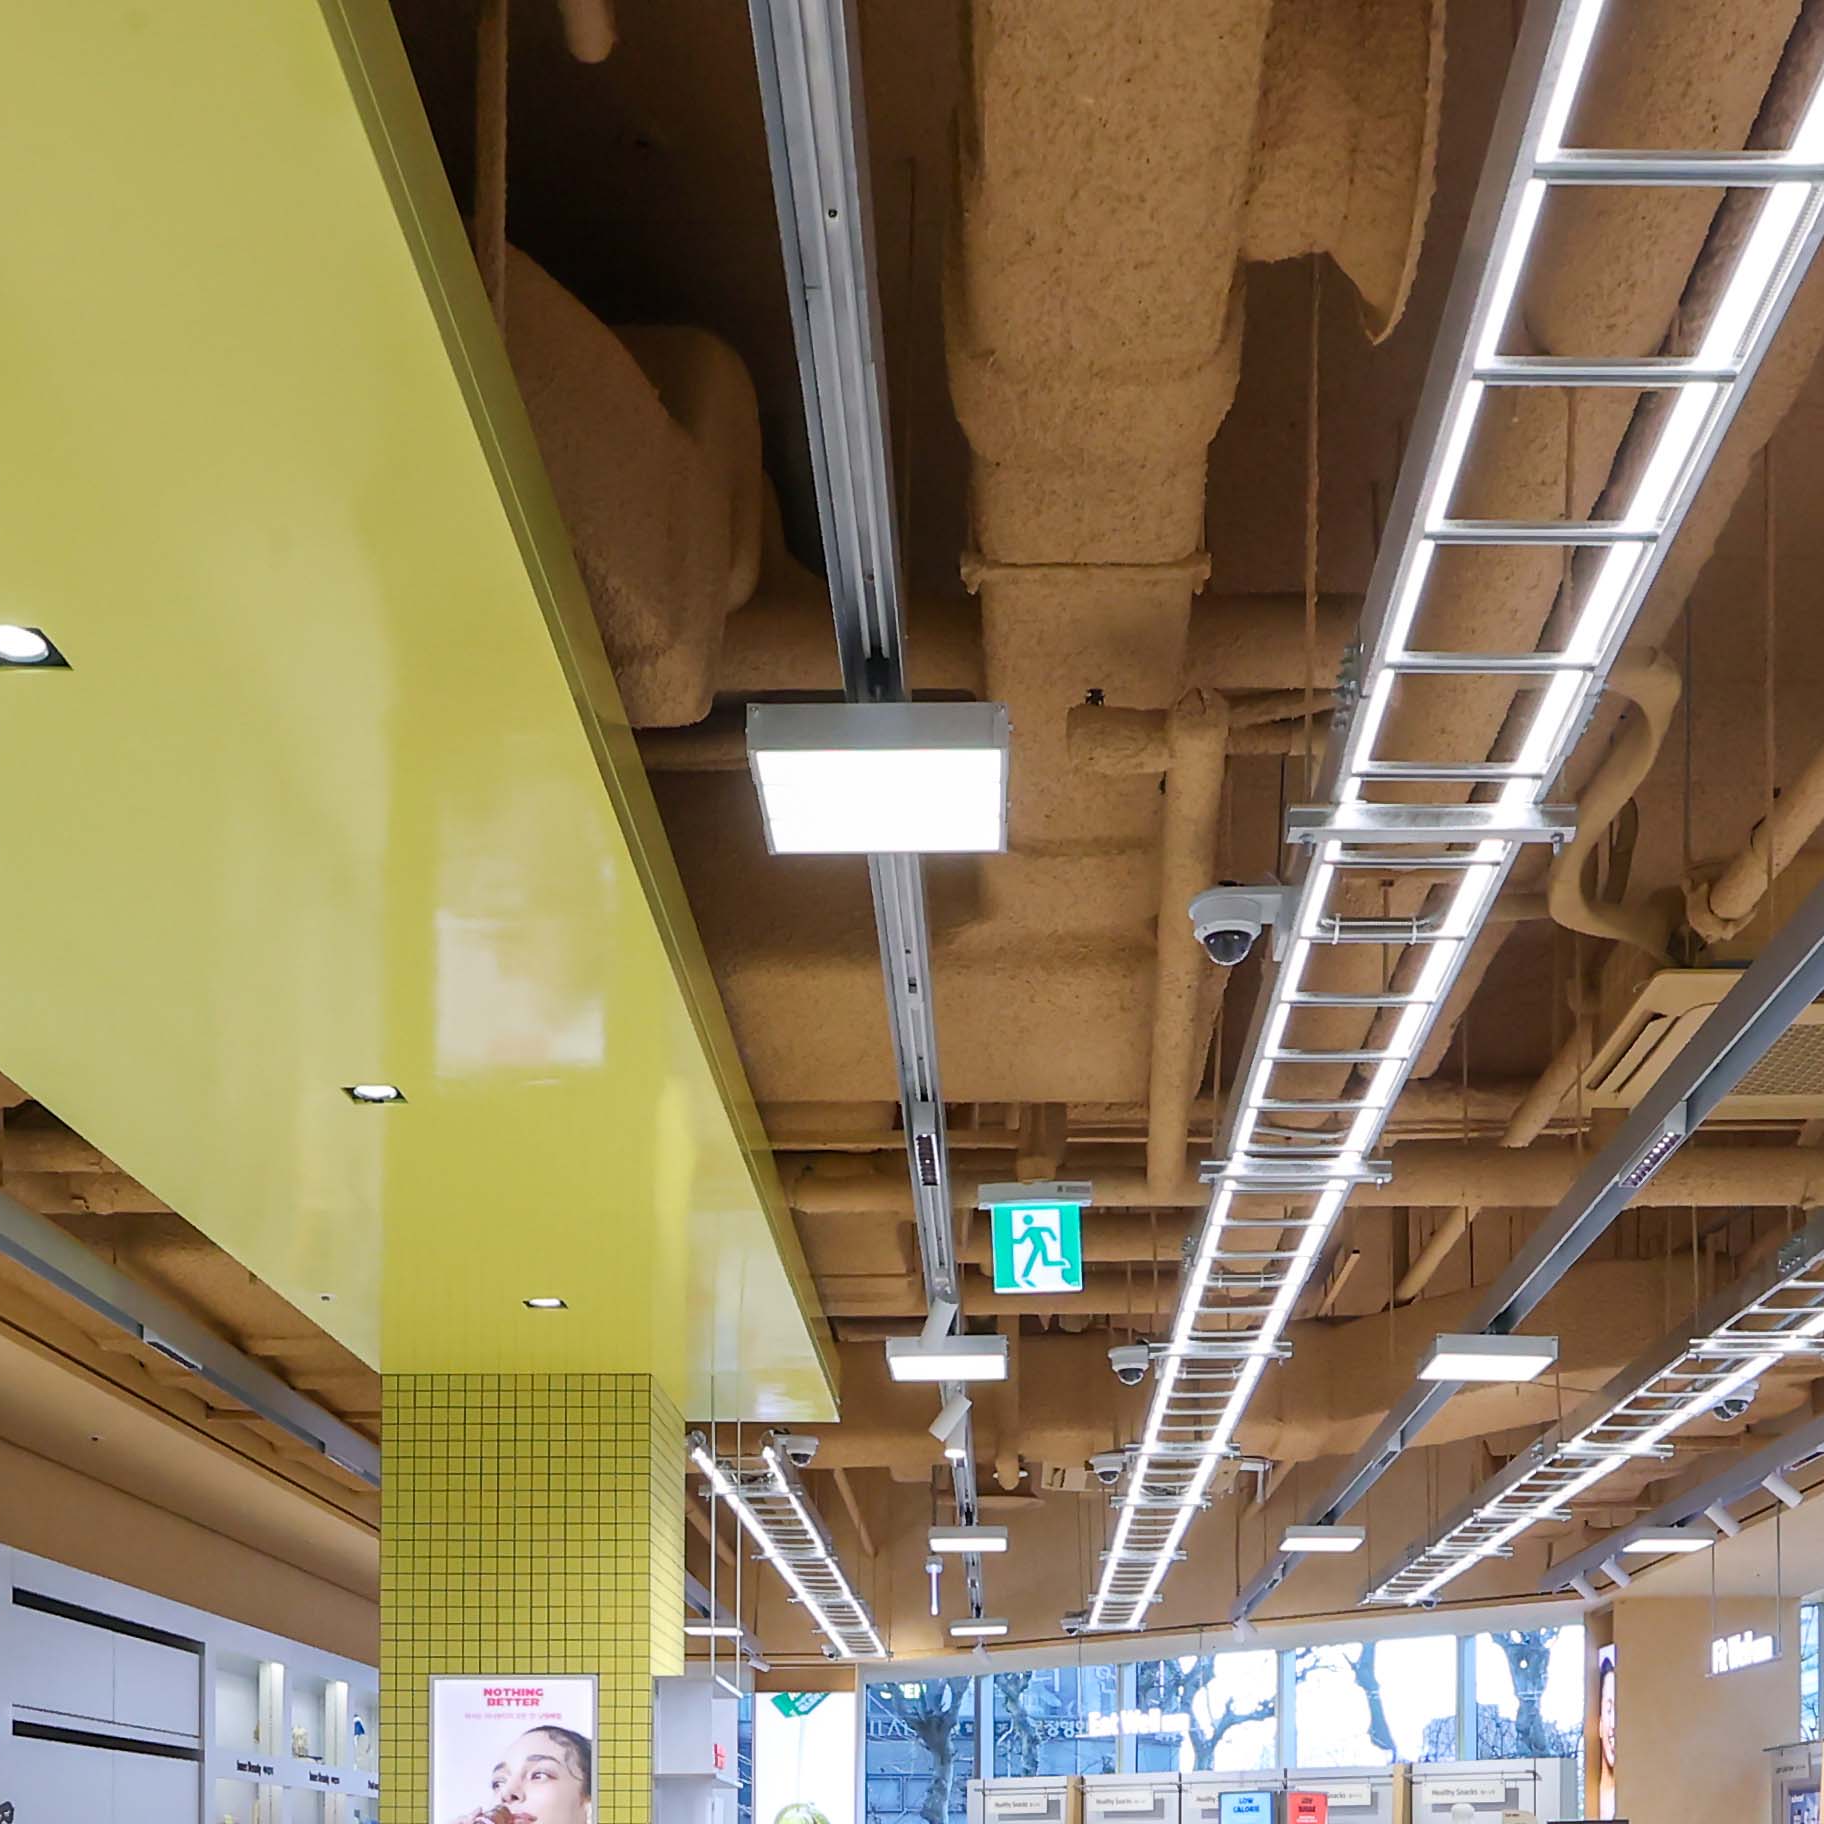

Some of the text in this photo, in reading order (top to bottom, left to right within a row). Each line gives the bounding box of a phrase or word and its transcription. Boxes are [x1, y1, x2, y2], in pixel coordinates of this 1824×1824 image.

[483, 1688, 544, 1697] NOTHING
[487, 1698, 540, 1707] BETTER
[1233, 1805, 1260, 1813] CALORIE
